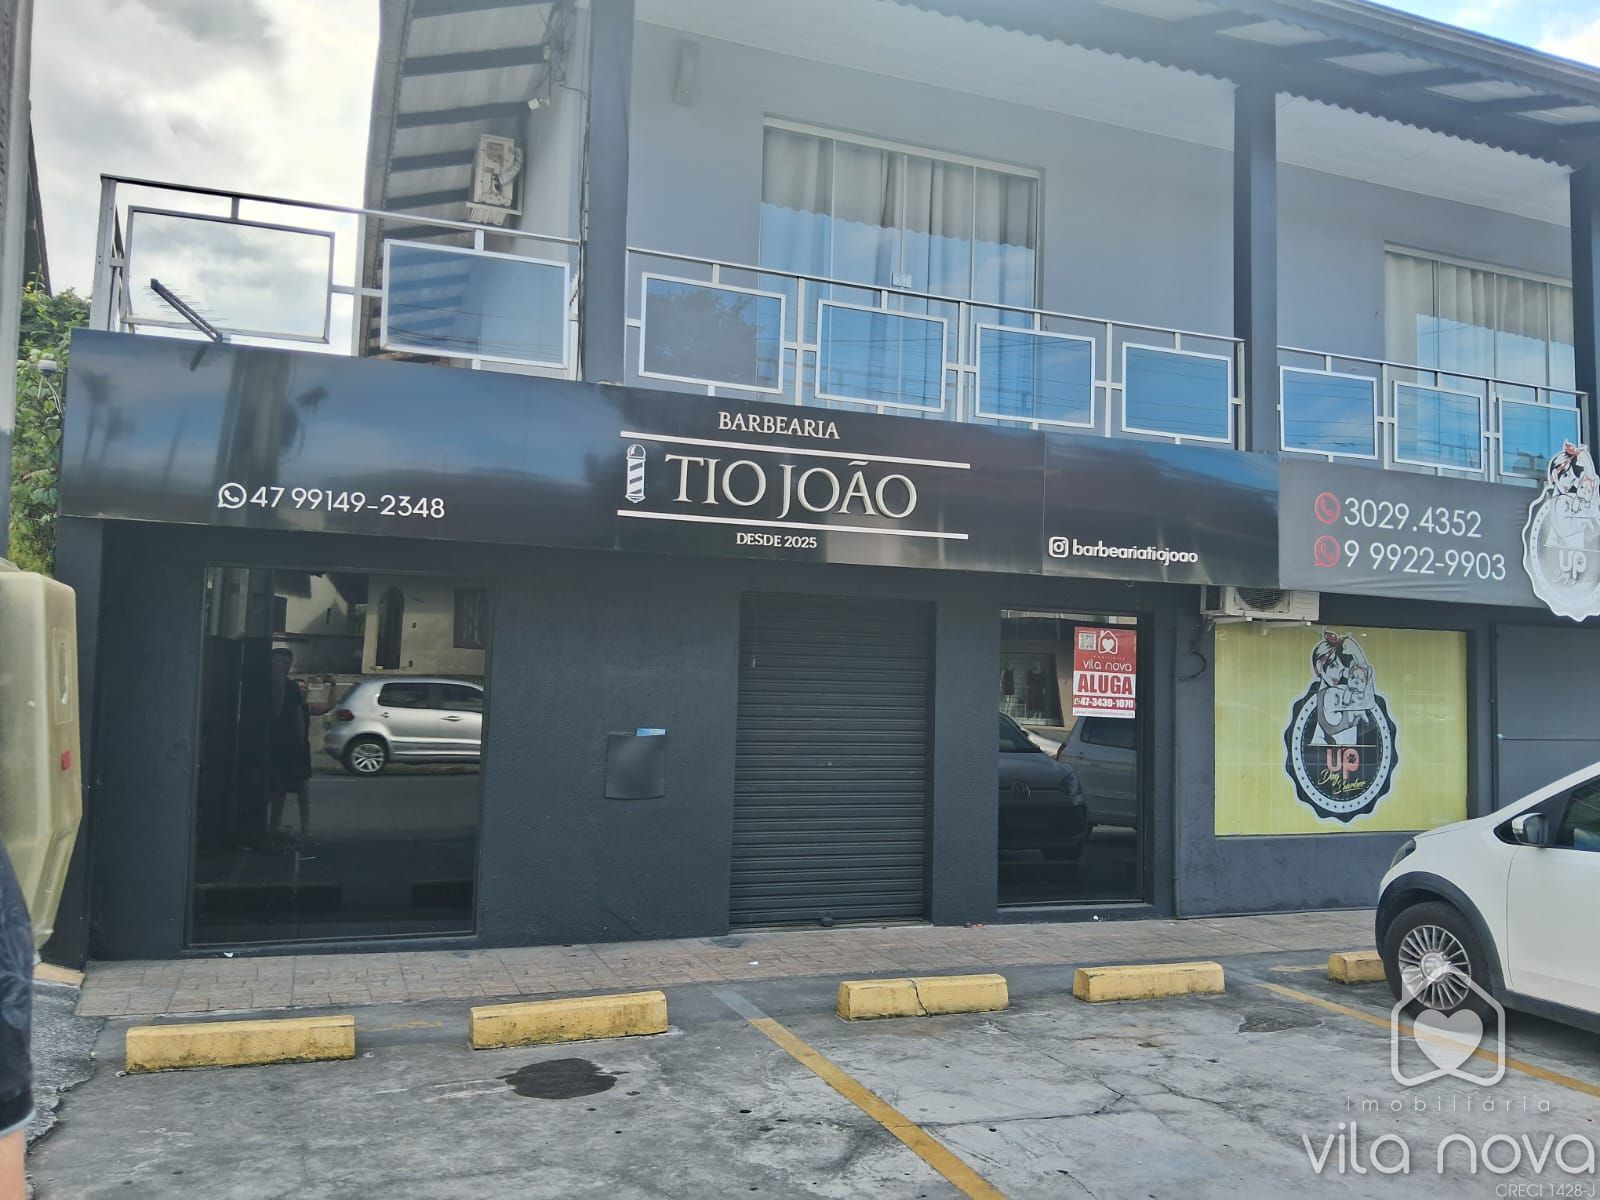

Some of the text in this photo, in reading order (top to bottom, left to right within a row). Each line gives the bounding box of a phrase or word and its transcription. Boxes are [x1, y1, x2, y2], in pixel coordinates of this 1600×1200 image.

[719, 412, 840, 439] BARBEARIA
[665, 454, 917, 518] TIO JOÃO
[250, 486, 446, 518] 47 99149-2348
[1343, 497, 1482, 538] 3029.4352
[736, 532, 818, 550] DESDE 2025
[1072, 538, 1199, 566] barbeariatiojoao
[1344, 540, 1507, 581] 9 9922-9903
[1082, 658, 1132, 672] vila nova
[1077, 673, 1133, 696] ALUGA
